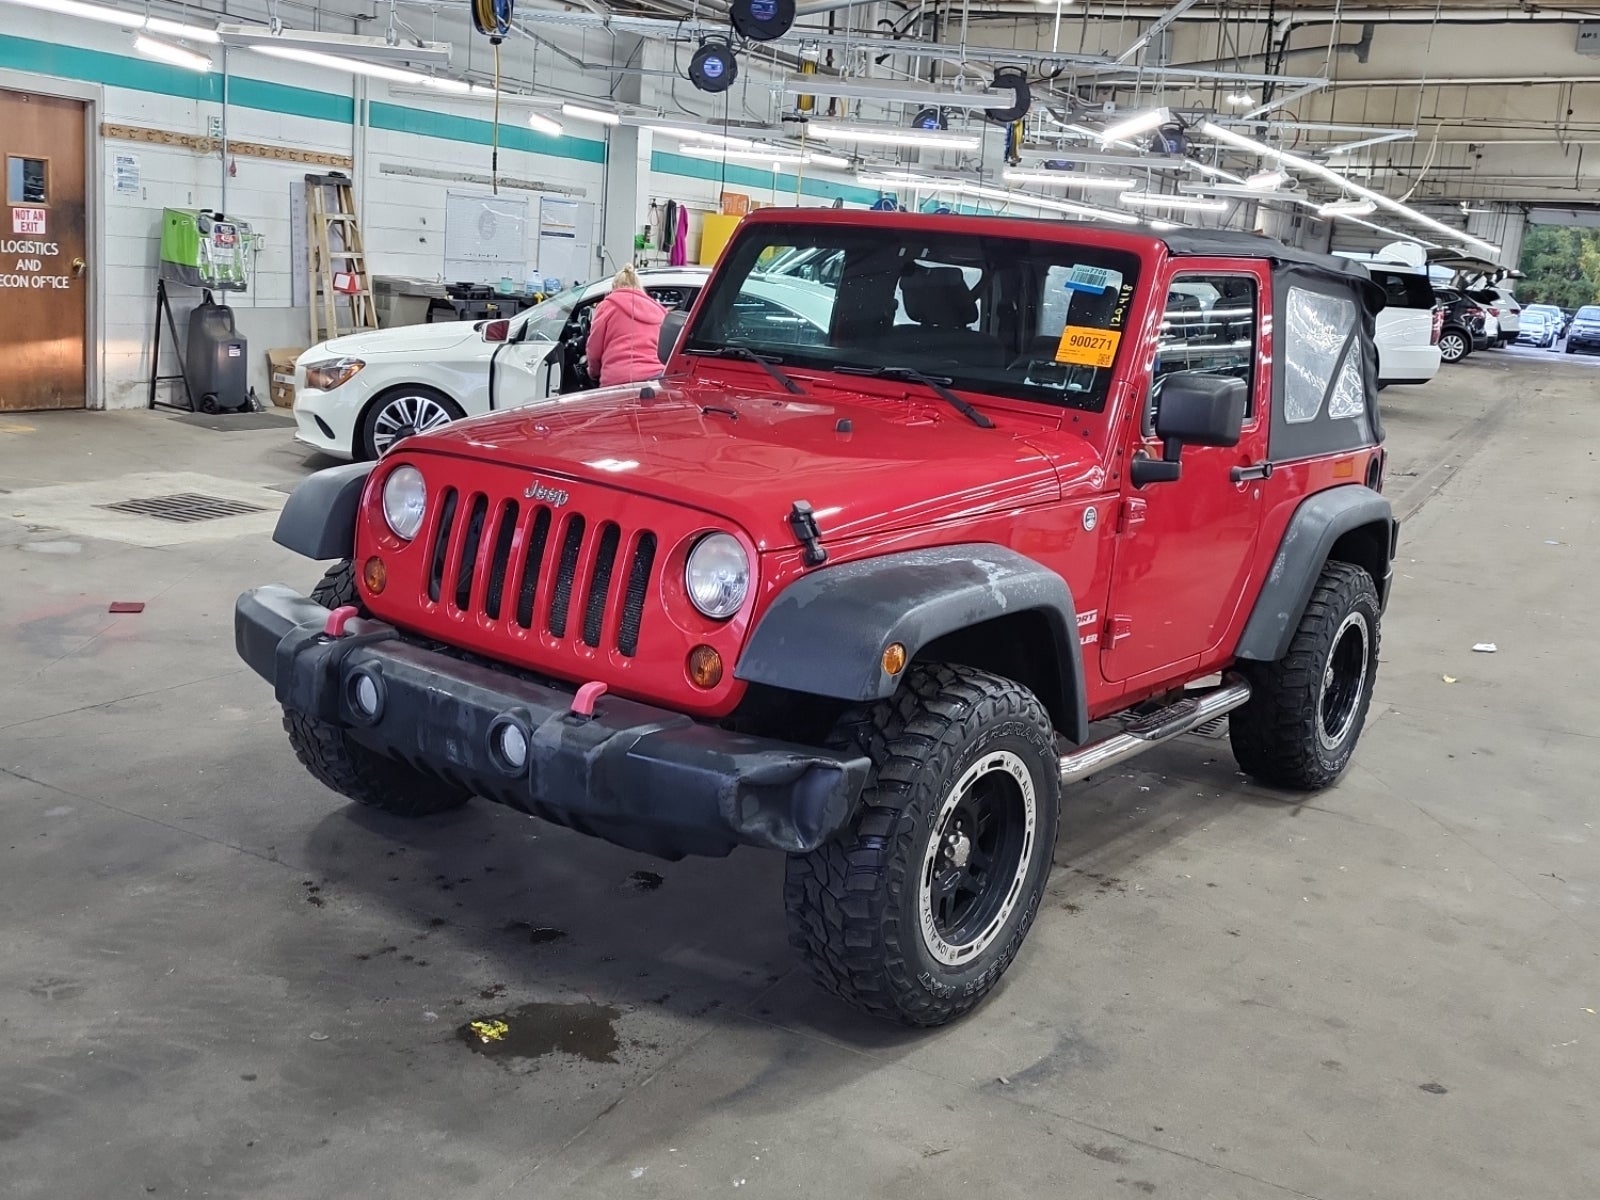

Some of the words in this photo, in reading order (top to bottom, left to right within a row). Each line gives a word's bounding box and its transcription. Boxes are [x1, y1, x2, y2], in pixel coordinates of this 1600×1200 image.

[15, 209, 31, 220] NOT
[33, 210, 44, 221] AN
[20, 221, 38, 232] EXIT
[0, 239, 60, 256] LOGISTICS
[15, 258, 42, 272] AND
[0, 274, 29, 288] ECON
[1069, 334, 1113, 351] 900271
[524, 479, 569, 508] Jeep
[1076, 612, 1097, 624] ORT
[1011, 763, 1023, 780] ION
[1021, 780, 1033, 814] ALLOY
[923, 906, 937, 942] ALLOY
[935, 940, 949, 956] ION
